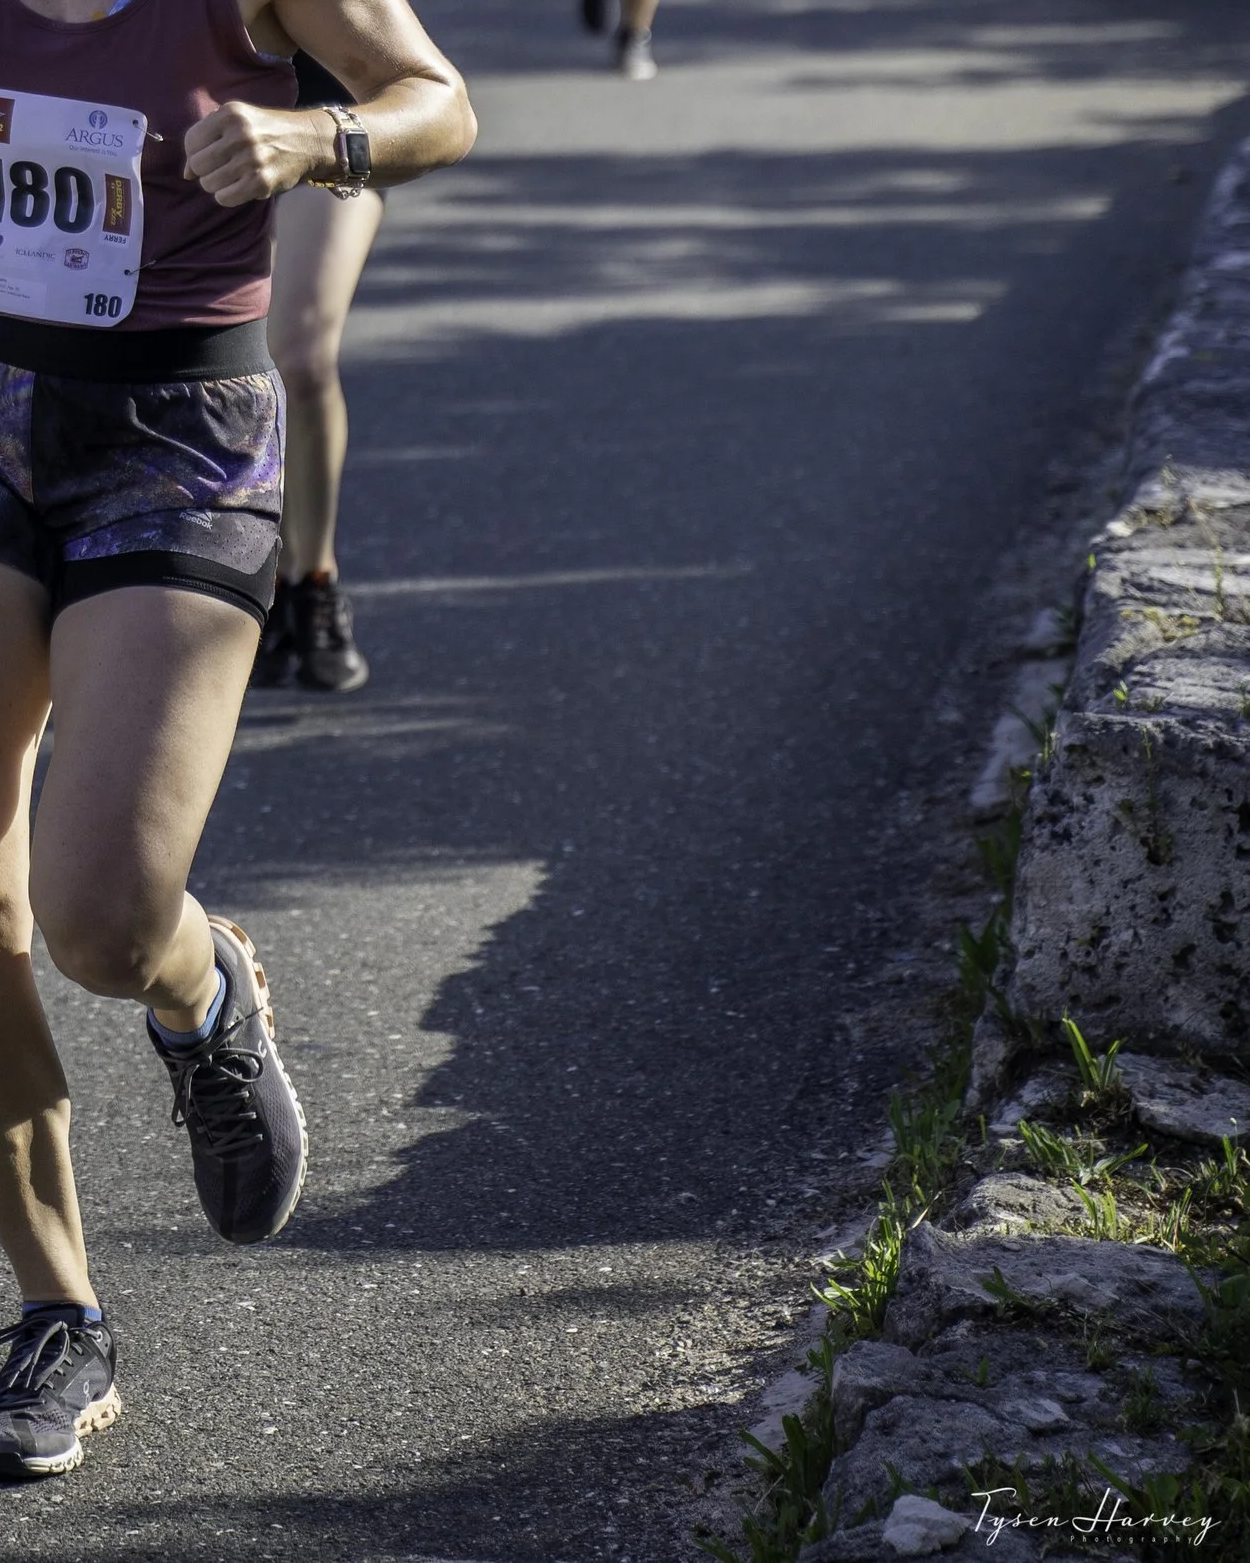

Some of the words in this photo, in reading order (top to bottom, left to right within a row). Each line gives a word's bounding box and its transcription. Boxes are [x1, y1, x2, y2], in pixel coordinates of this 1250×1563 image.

[64, 128, 124, 147] ARGUS
[103, 234, 127, 245] FERRY
[84, 293, 123, 318] 180
[180, 512, 213, 530] Reebok
